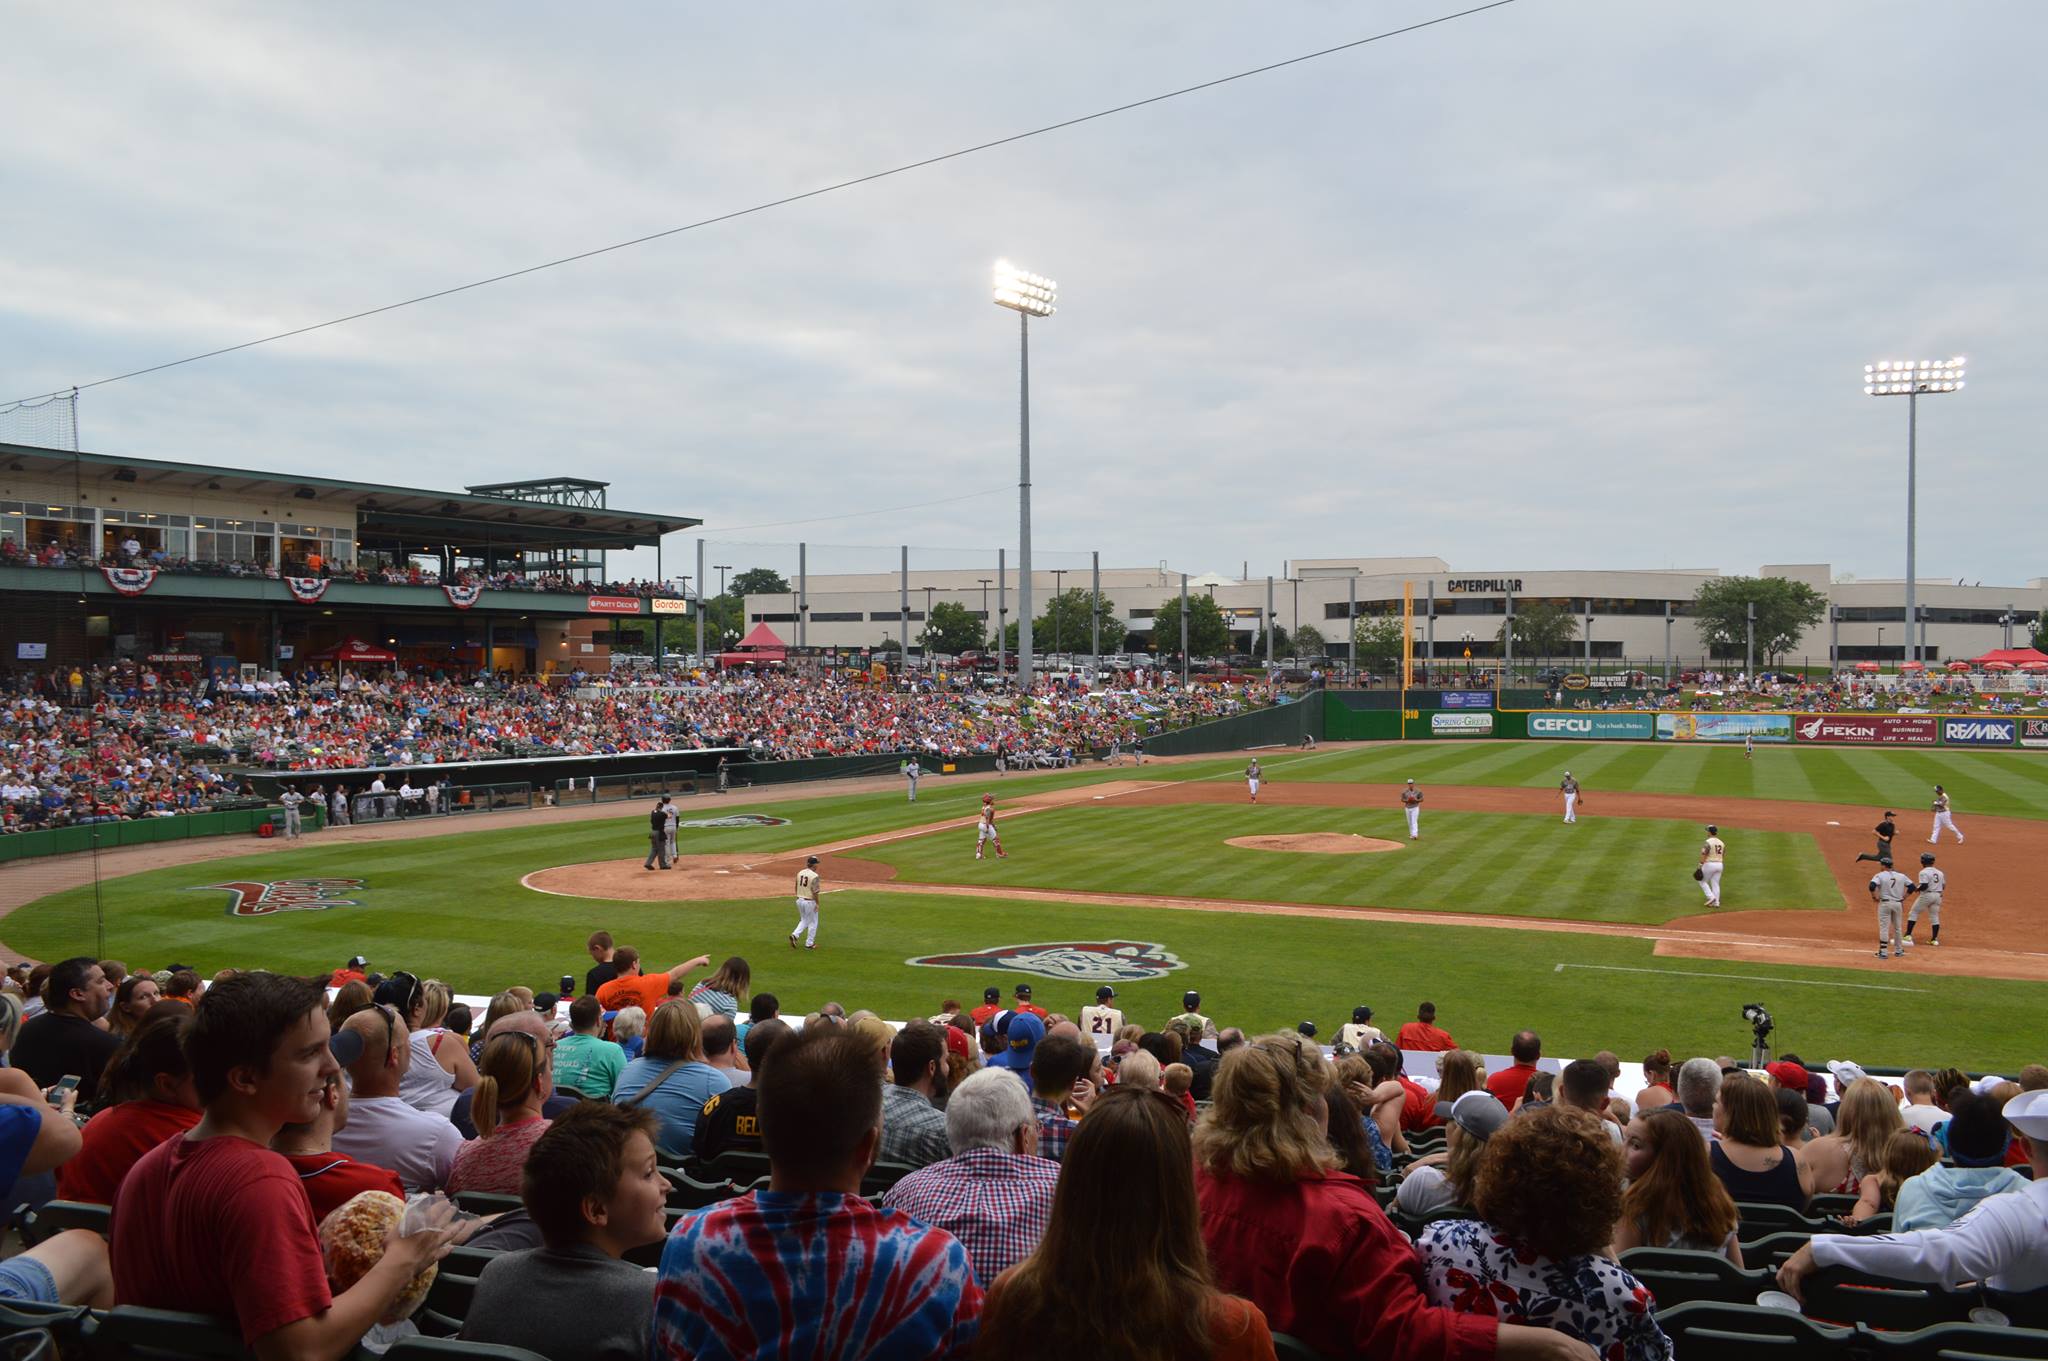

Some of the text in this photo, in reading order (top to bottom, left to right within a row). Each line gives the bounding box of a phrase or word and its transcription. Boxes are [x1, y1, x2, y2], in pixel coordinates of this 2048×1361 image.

[1448, 579, 1522, 592] CATERPILLAR
[616, 601, 633, 609] DECK
[655, 600, 685, 609] Gordon
[1405, 709, 1419, 719] 310
[1533, 718, 1592, 732] CEFCU
[1822, 726, 1875, 737] PEKIN
[1945, 722, 2011, 740] RE/MAX
[1714, 844, 1722, 855] 12
[800, 875, 809, 887] 13
[1890, 878, 1897, 889] 7
[1932, 873, 1939, 883] 3
[1092, 1016, 1112, 1034] 21
[735, 1115, 764, 1136] BEL
